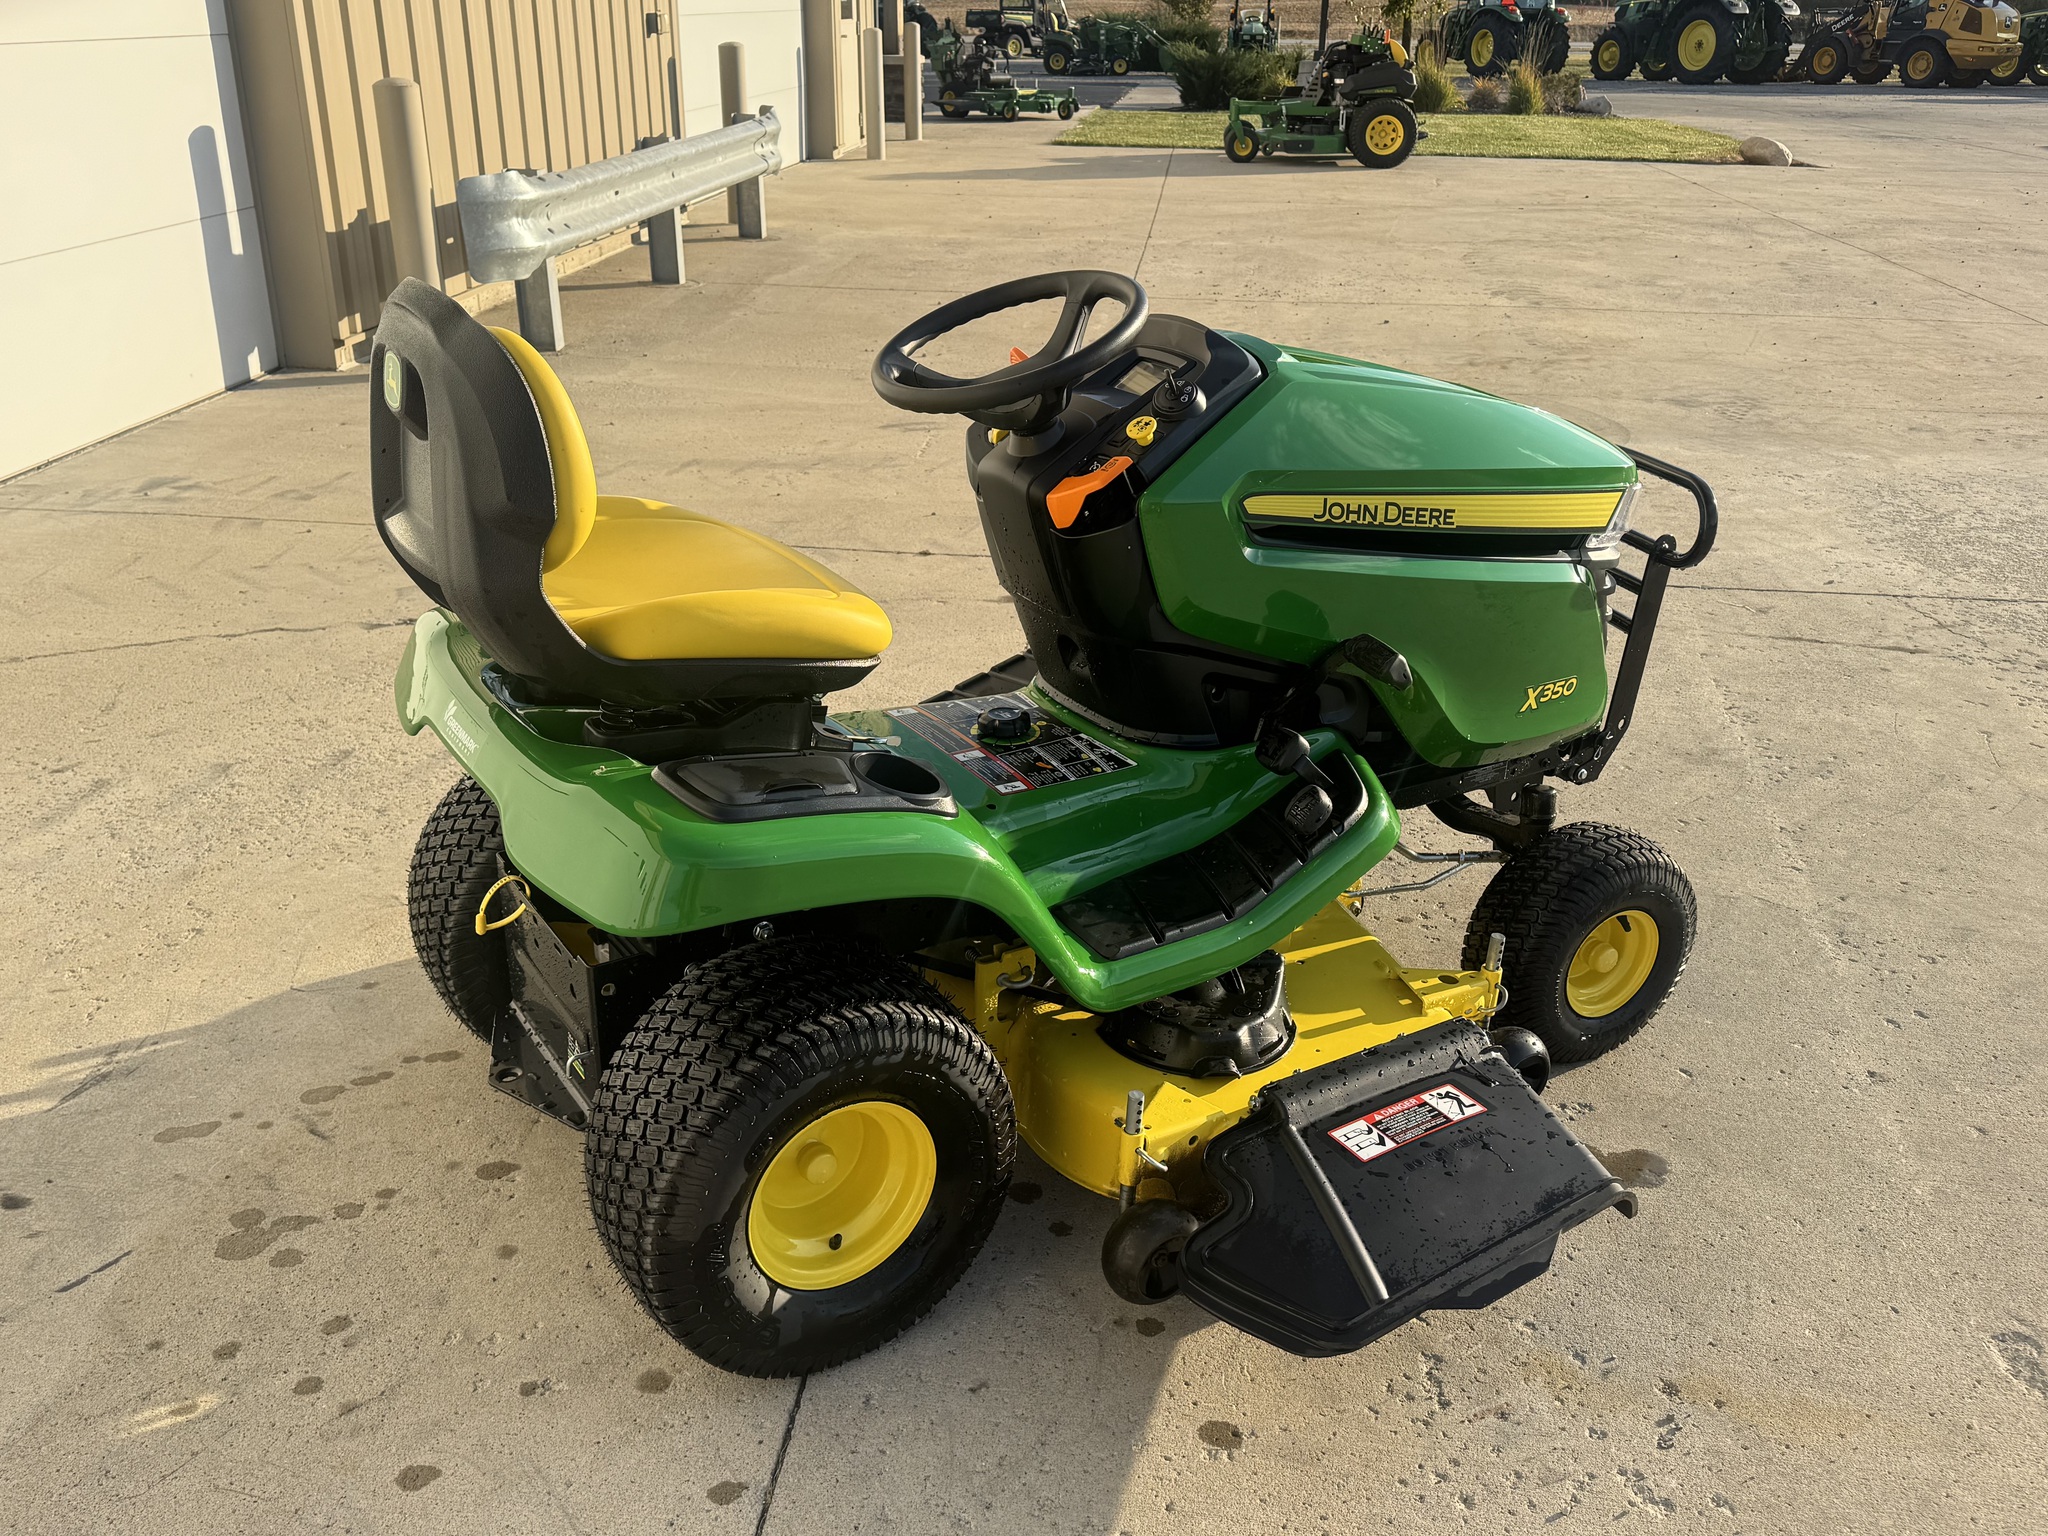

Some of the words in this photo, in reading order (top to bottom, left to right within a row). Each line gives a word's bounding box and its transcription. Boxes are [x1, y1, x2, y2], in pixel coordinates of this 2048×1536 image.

[1831, 14, 1855, 32] DEERE
[1313, 497, 1379, 524] JOHN
[1384, 501, 1456, 527] DEERE
[1519, 677, 1578, 713] X350
[446, 715, 479, 754] GREENMARK
[1380, 1098, 1420, 1117] DANGER
